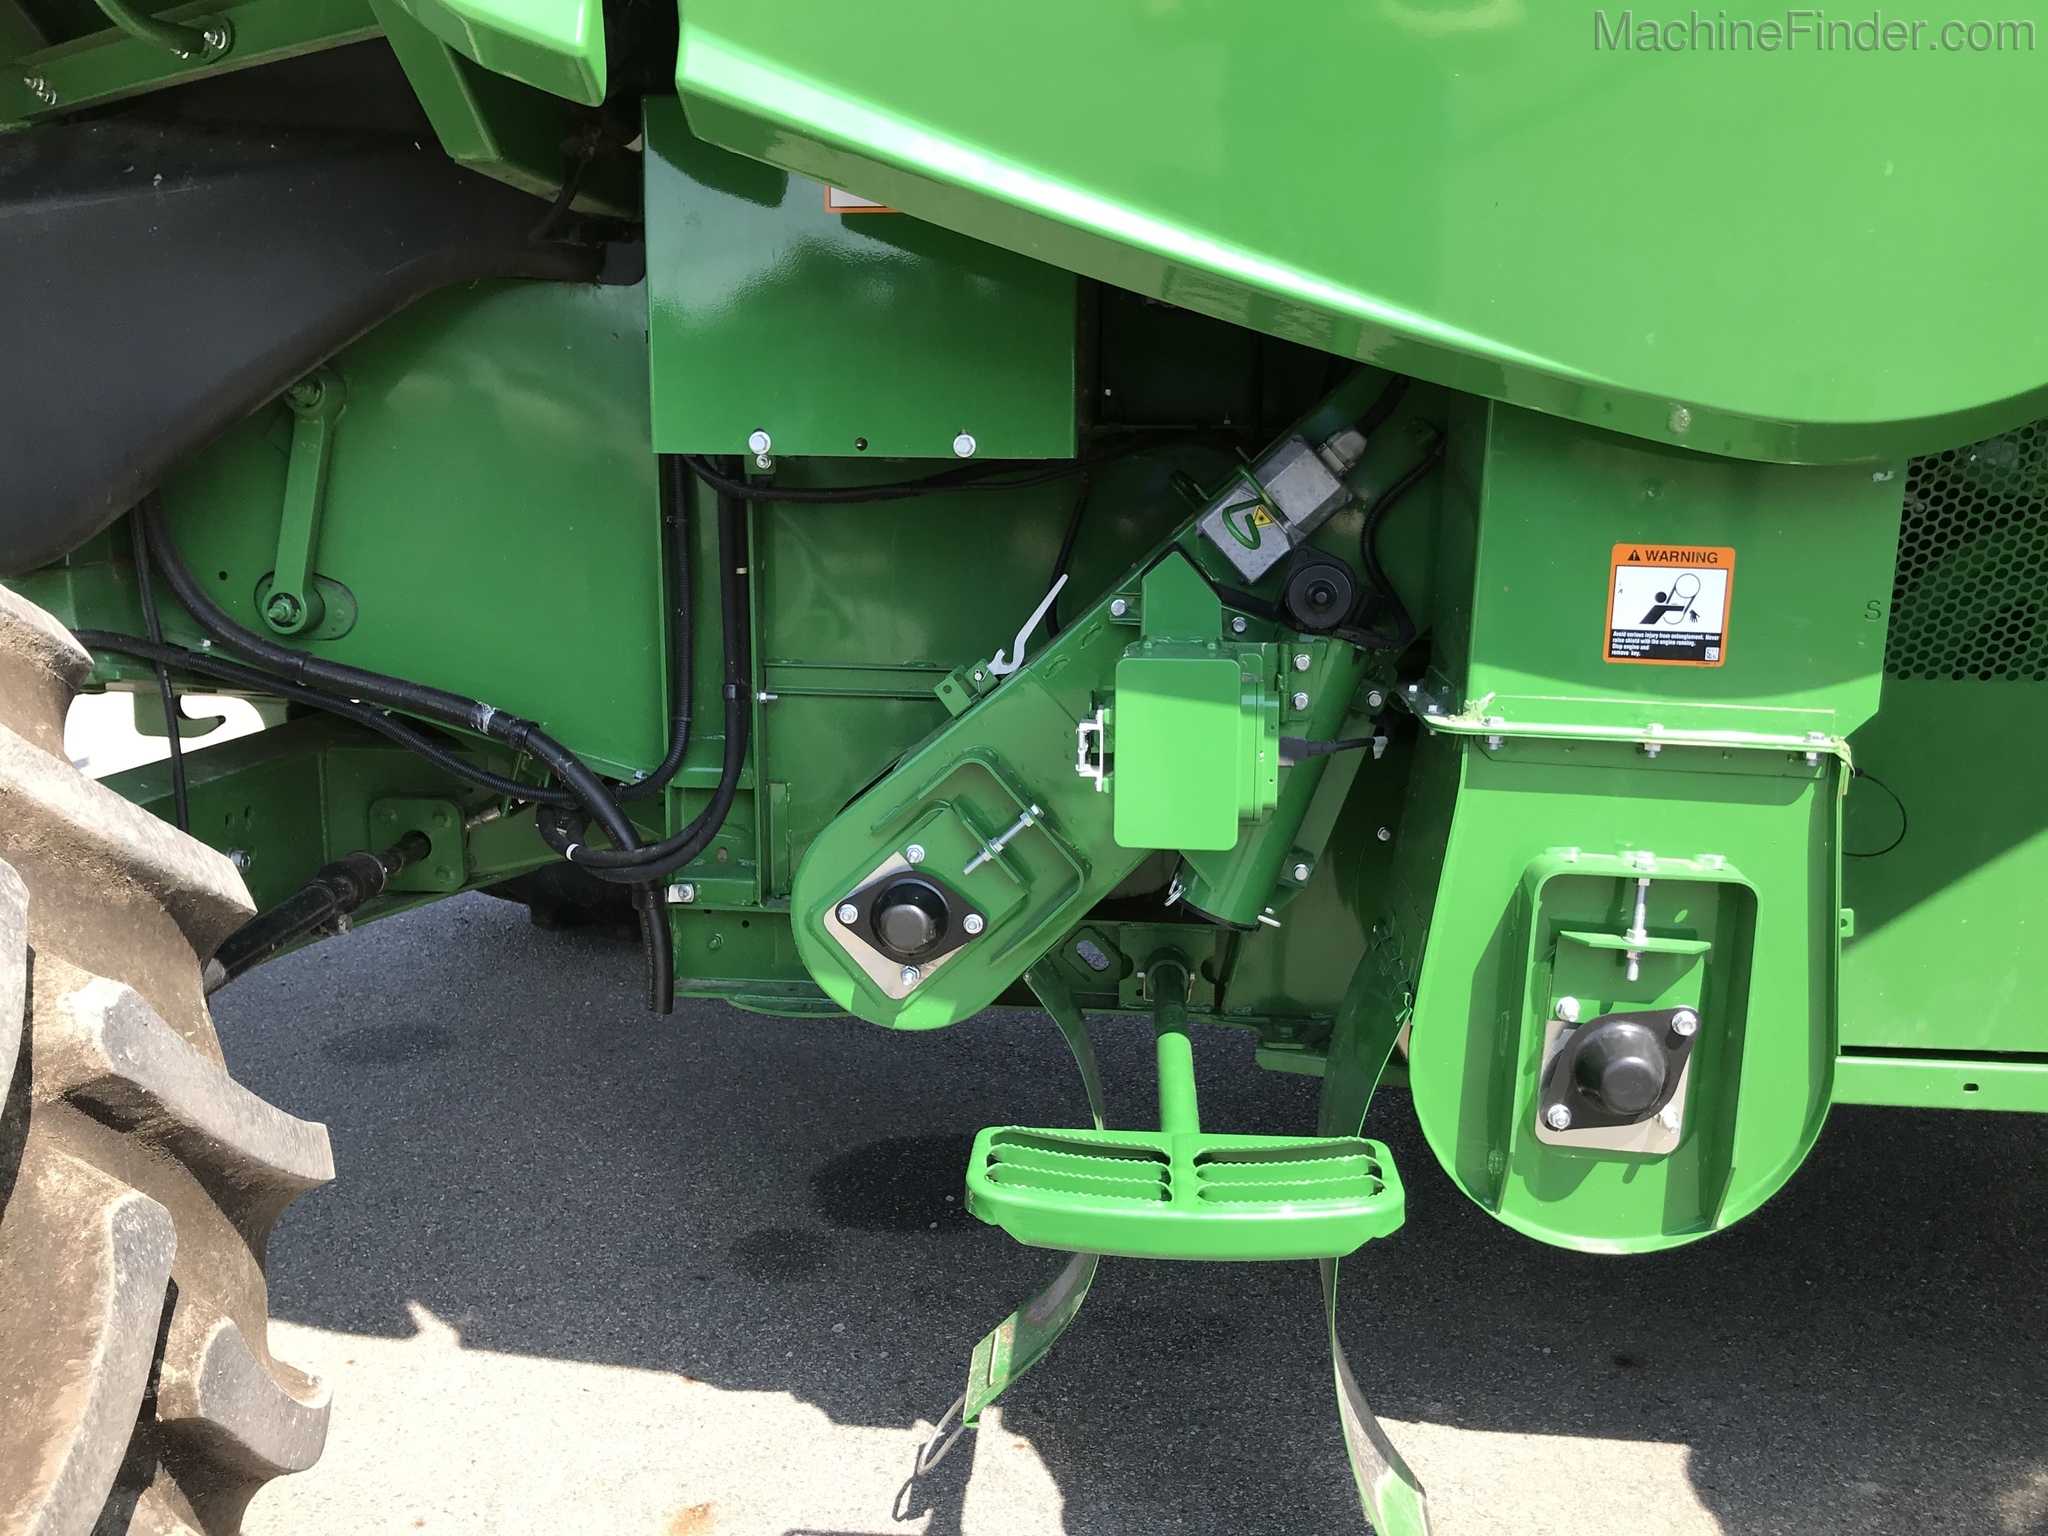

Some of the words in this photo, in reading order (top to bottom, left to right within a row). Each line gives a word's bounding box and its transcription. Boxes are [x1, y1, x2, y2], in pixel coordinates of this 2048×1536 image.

[1645, 550, 1718, 564] WARNING
[1645, 632, 1659, 640] injury
[1671, 633, 1704, 641] entanglement.
[1660, 639, 1676, 647] engine
